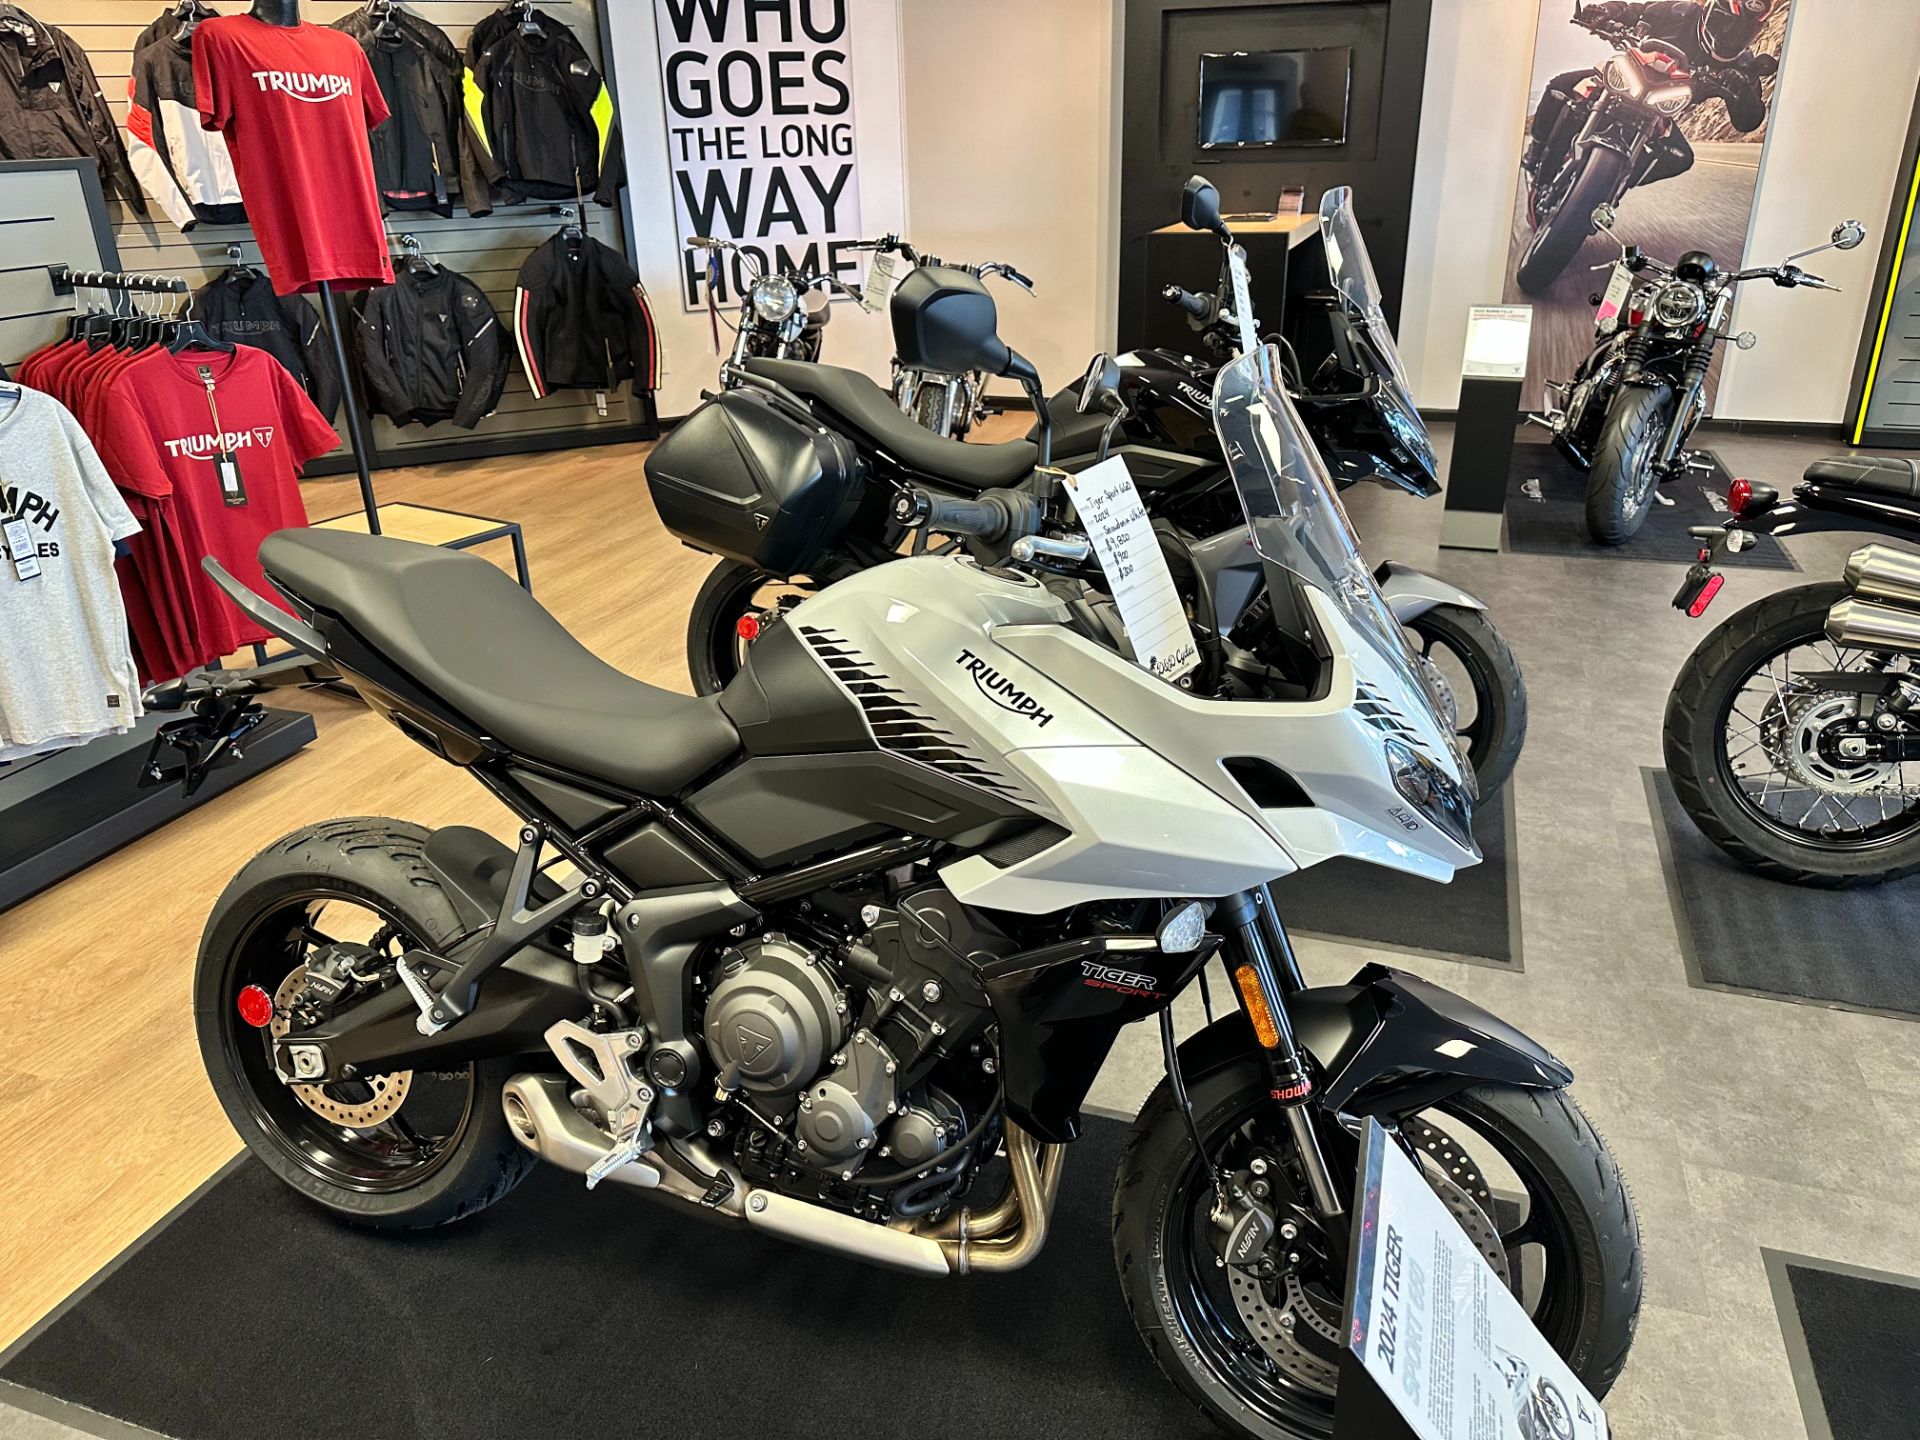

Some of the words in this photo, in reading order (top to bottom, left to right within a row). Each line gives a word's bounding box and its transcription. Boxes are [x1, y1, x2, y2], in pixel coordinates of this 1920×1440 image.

[252, 71, 352, 103] TRIUMPH
[666, 50, 850, 118] GOES
[672, 126, 747, 161] THE
[760, 123, 853, 158] LONG
[676, 164, 854, 240] WAY
[164, 431, 252, 461] TRIUMPH
[1086, 496, 1103, 510] Tiger
[1103, 486, 1119, 501] Sport
[1093, 508, 1110, 523] 2024
[955, 648, 1054, 728] TRIUMPH
[1081, 960, 1157, 991] TIGER
[1083, 979, 1167, 999] SPORT
[1383, 1223, 1403, 1301] TIGER
[1377, 1297, 1399, 1375] 2024
